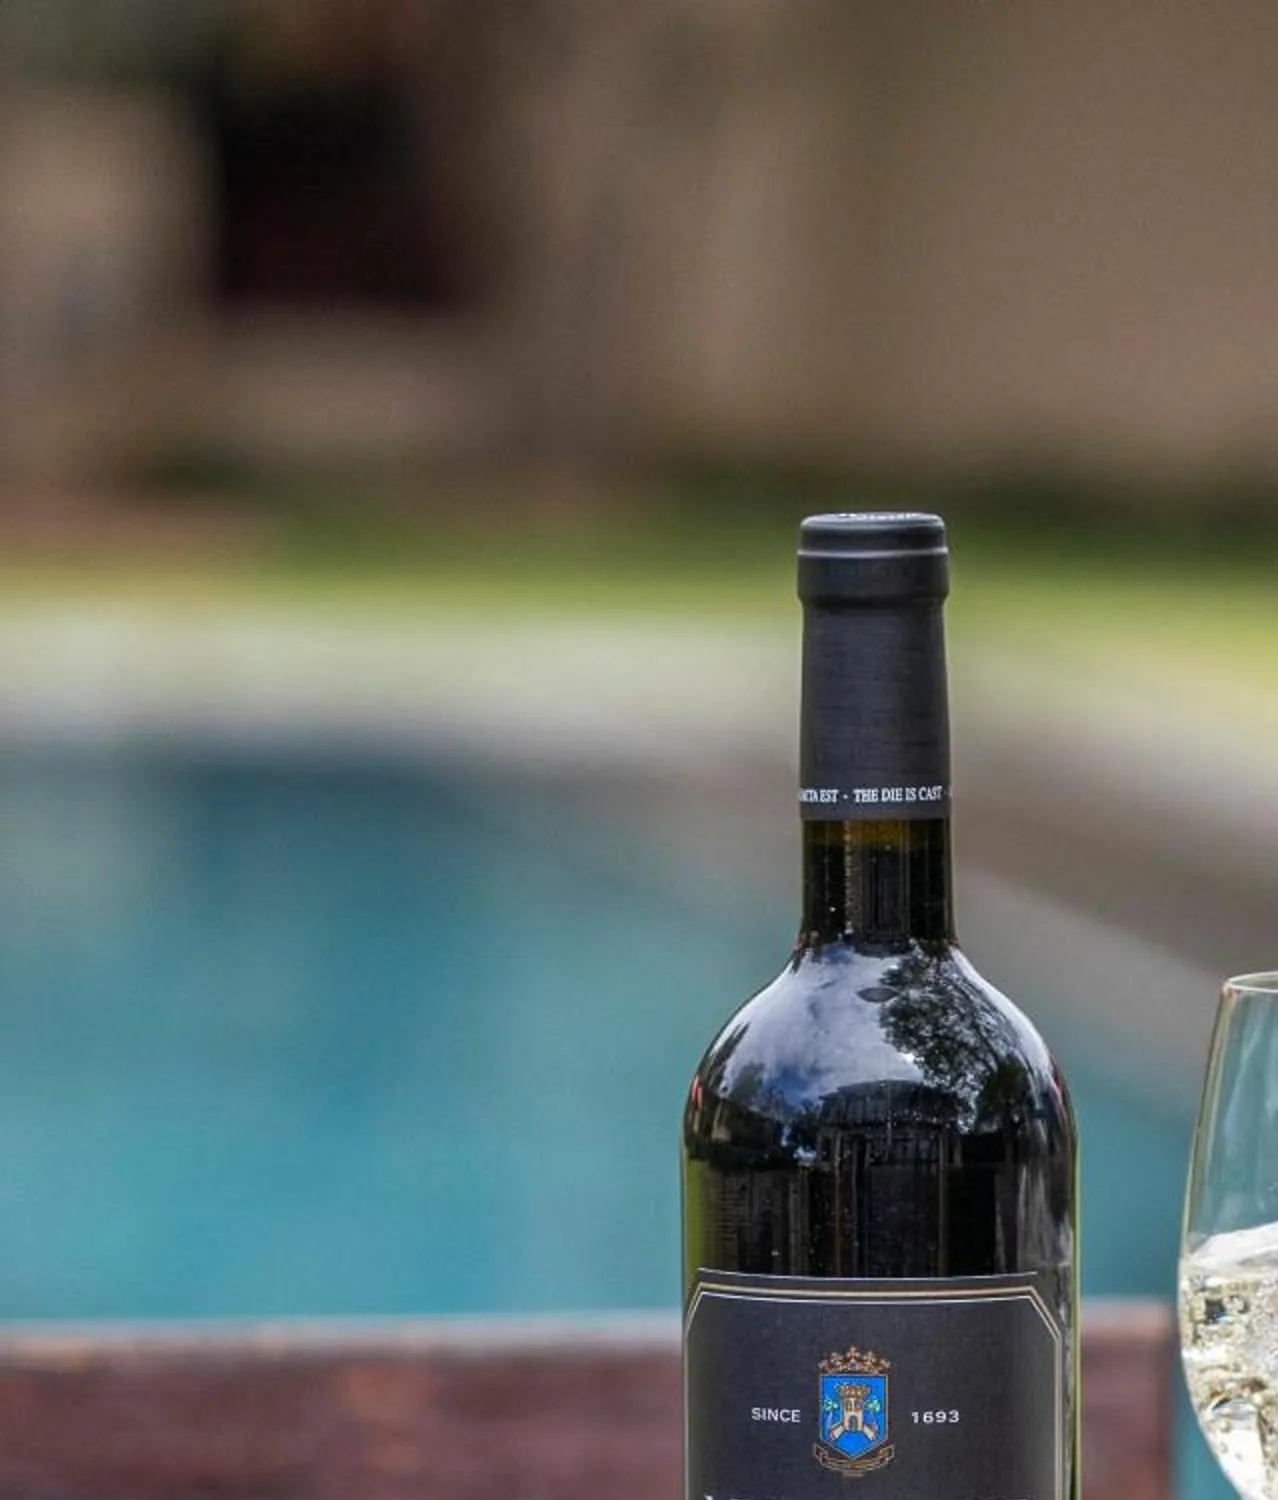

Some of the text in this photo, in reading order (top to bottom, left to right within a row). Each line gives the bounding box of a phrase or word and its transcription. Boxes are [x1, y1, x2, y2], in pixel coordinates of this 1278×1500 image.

[853, 789, 879, 803] THE
[881, 787, 903, 801] DIE
[905, 787, 917, 800] IS
[918, 785, 943, 800] CAST
[751, 1407, 801, 1423] SINCE
[911, 1410, 960, 1424] 1693
